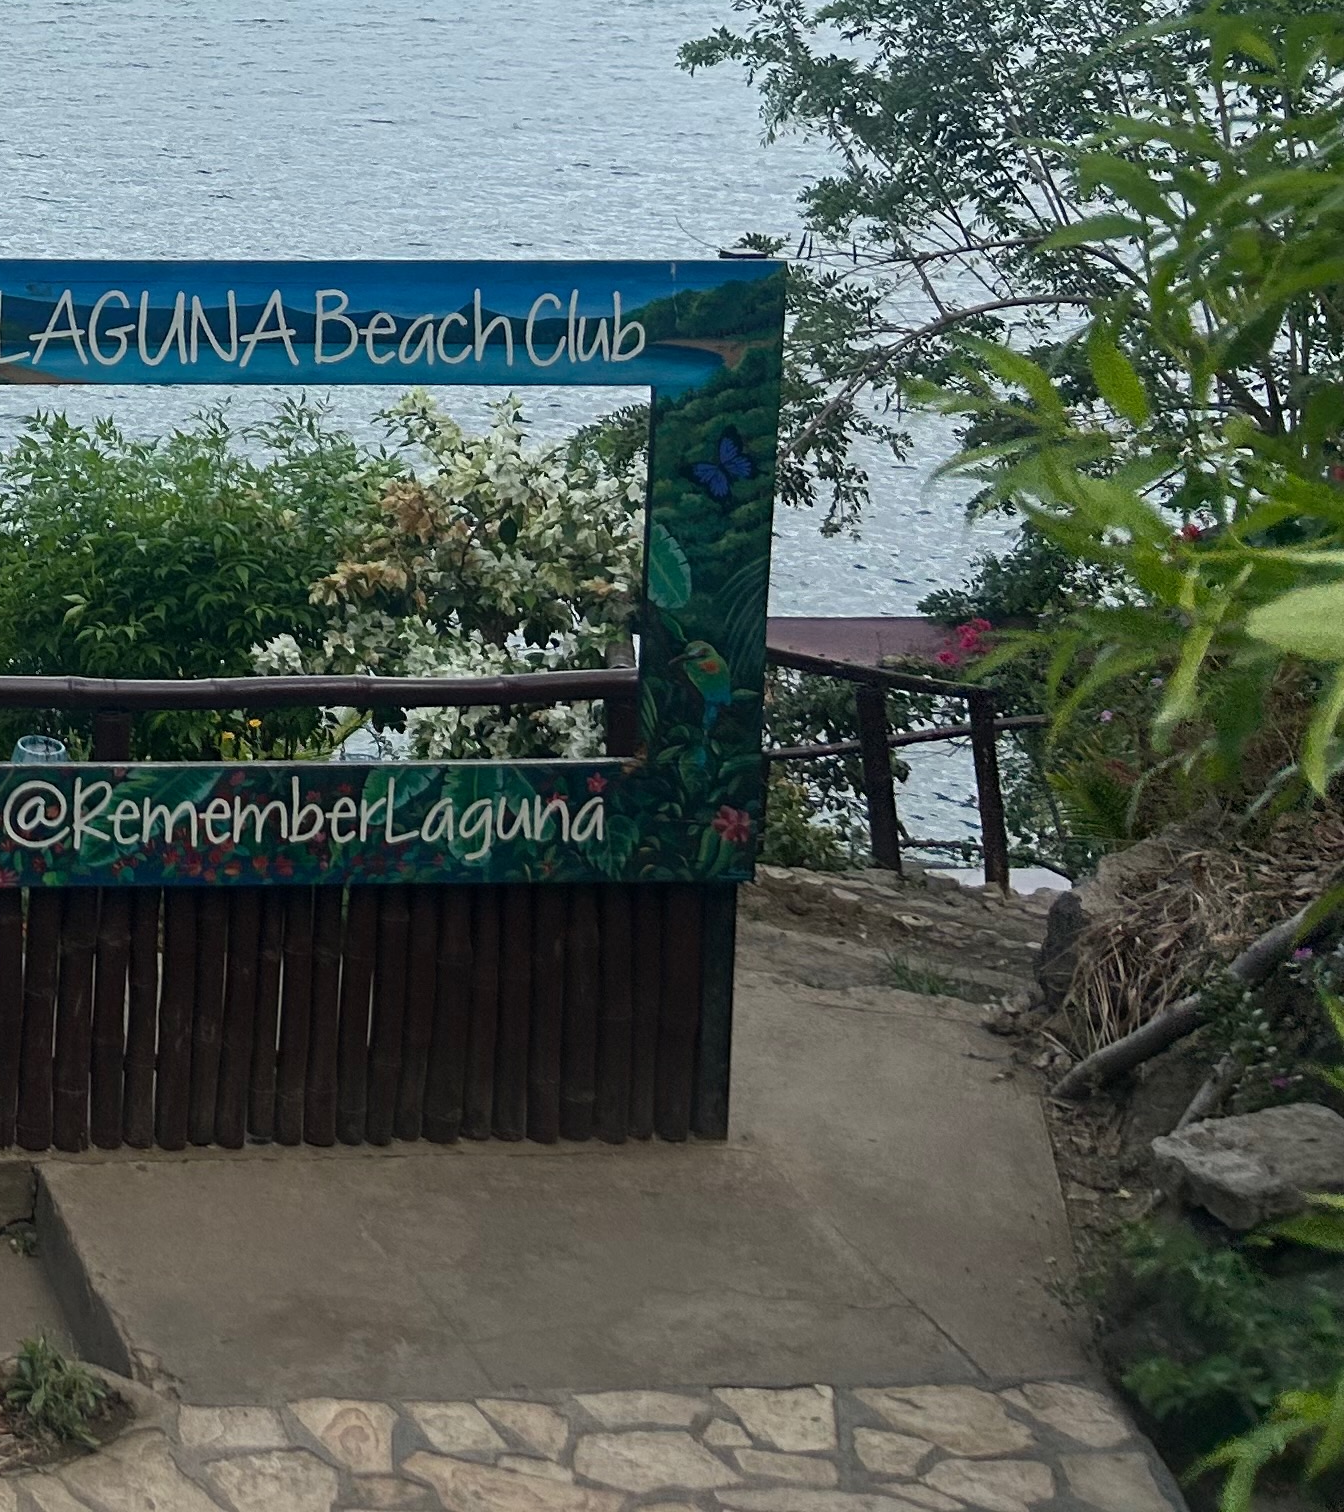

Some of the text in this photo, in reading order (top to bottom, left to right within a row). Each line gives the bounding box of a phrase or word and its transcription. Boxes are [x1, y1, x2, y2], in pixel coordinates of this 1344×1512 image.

[314, 288, 513, 367] Beach
[525, 289, 646, 366] Club
[3, 776, 604, 861] @RememberLaguna
